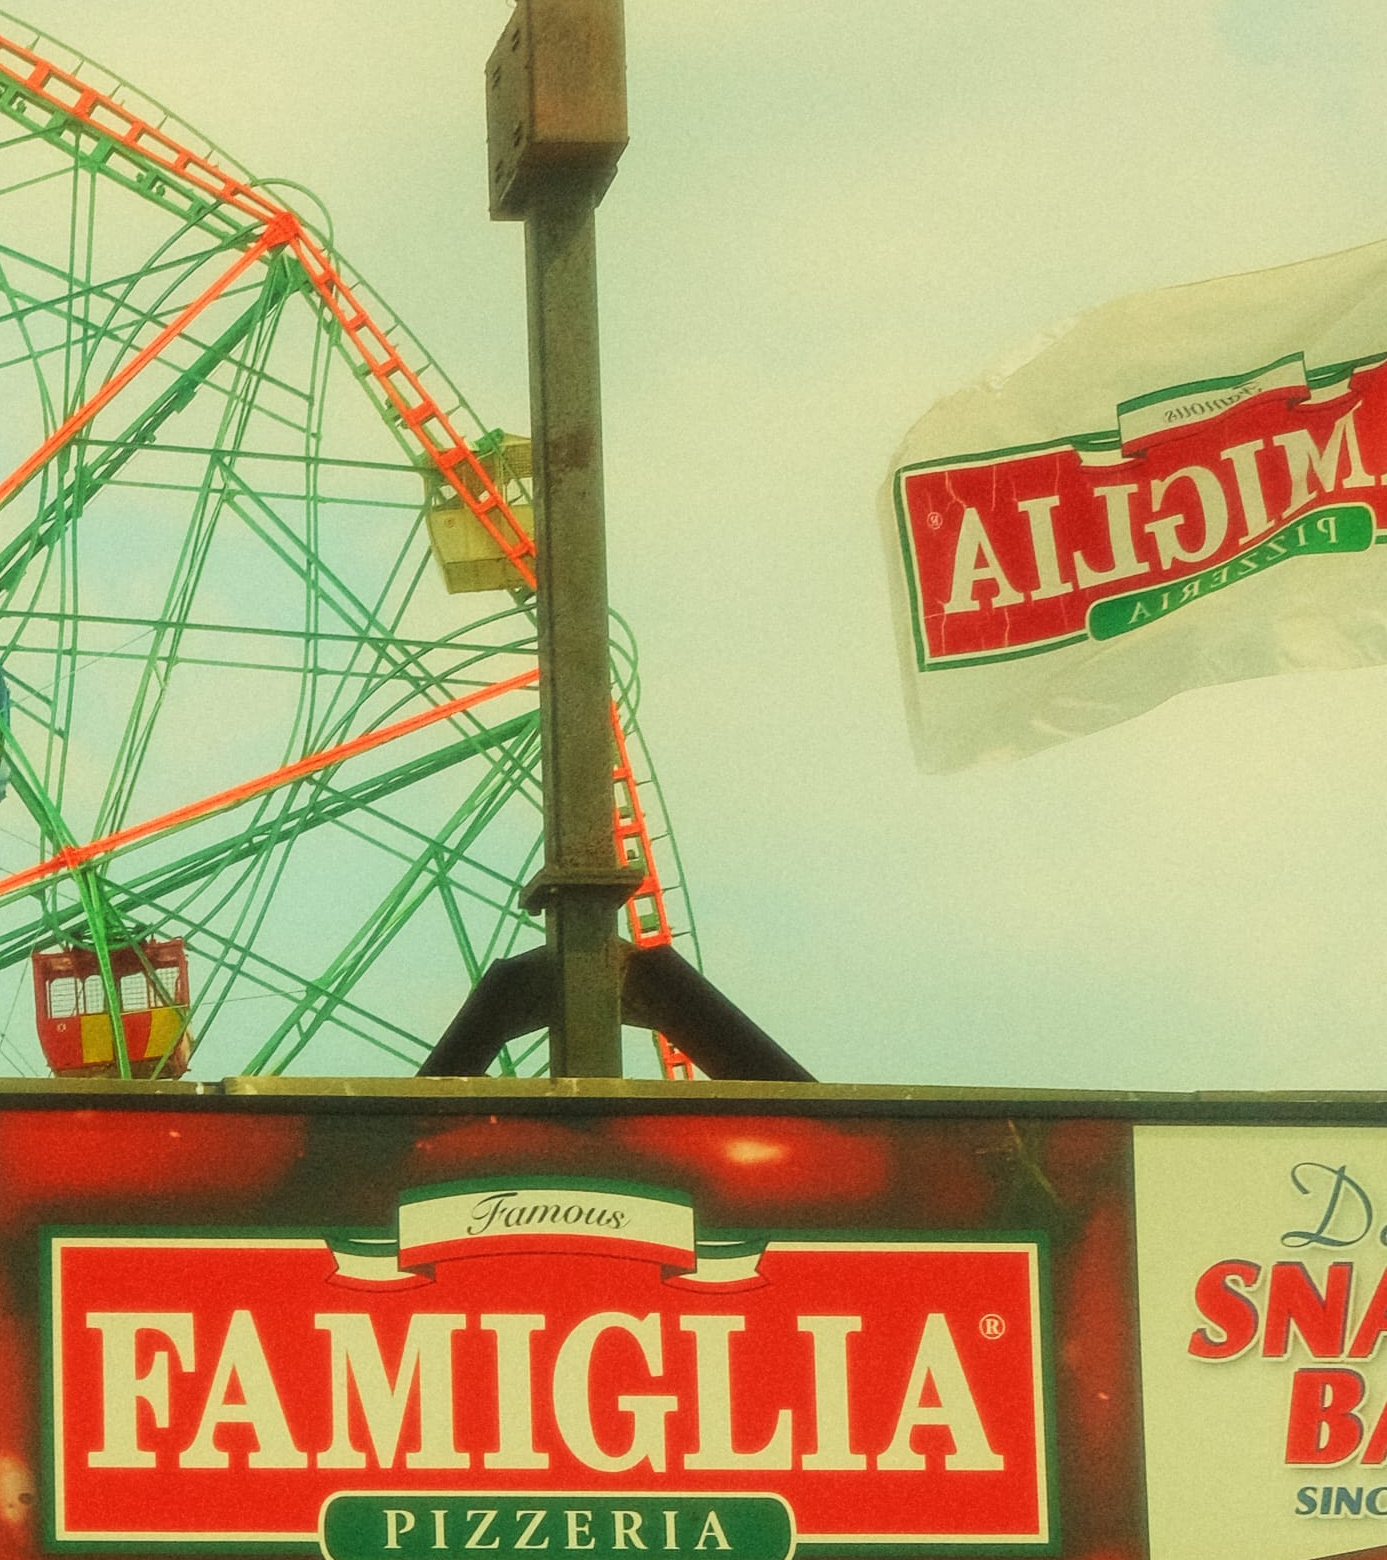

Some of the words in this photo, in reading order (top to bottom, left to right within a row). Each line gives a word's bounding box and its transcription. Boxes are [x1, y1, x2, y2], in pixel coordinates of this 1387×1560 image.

[466, 1190, 631, 1237] Famous
[85, 1309, 1005, 1474] FAMIGLIA
[383, 1507, 735, 1552] PIZZERIA
